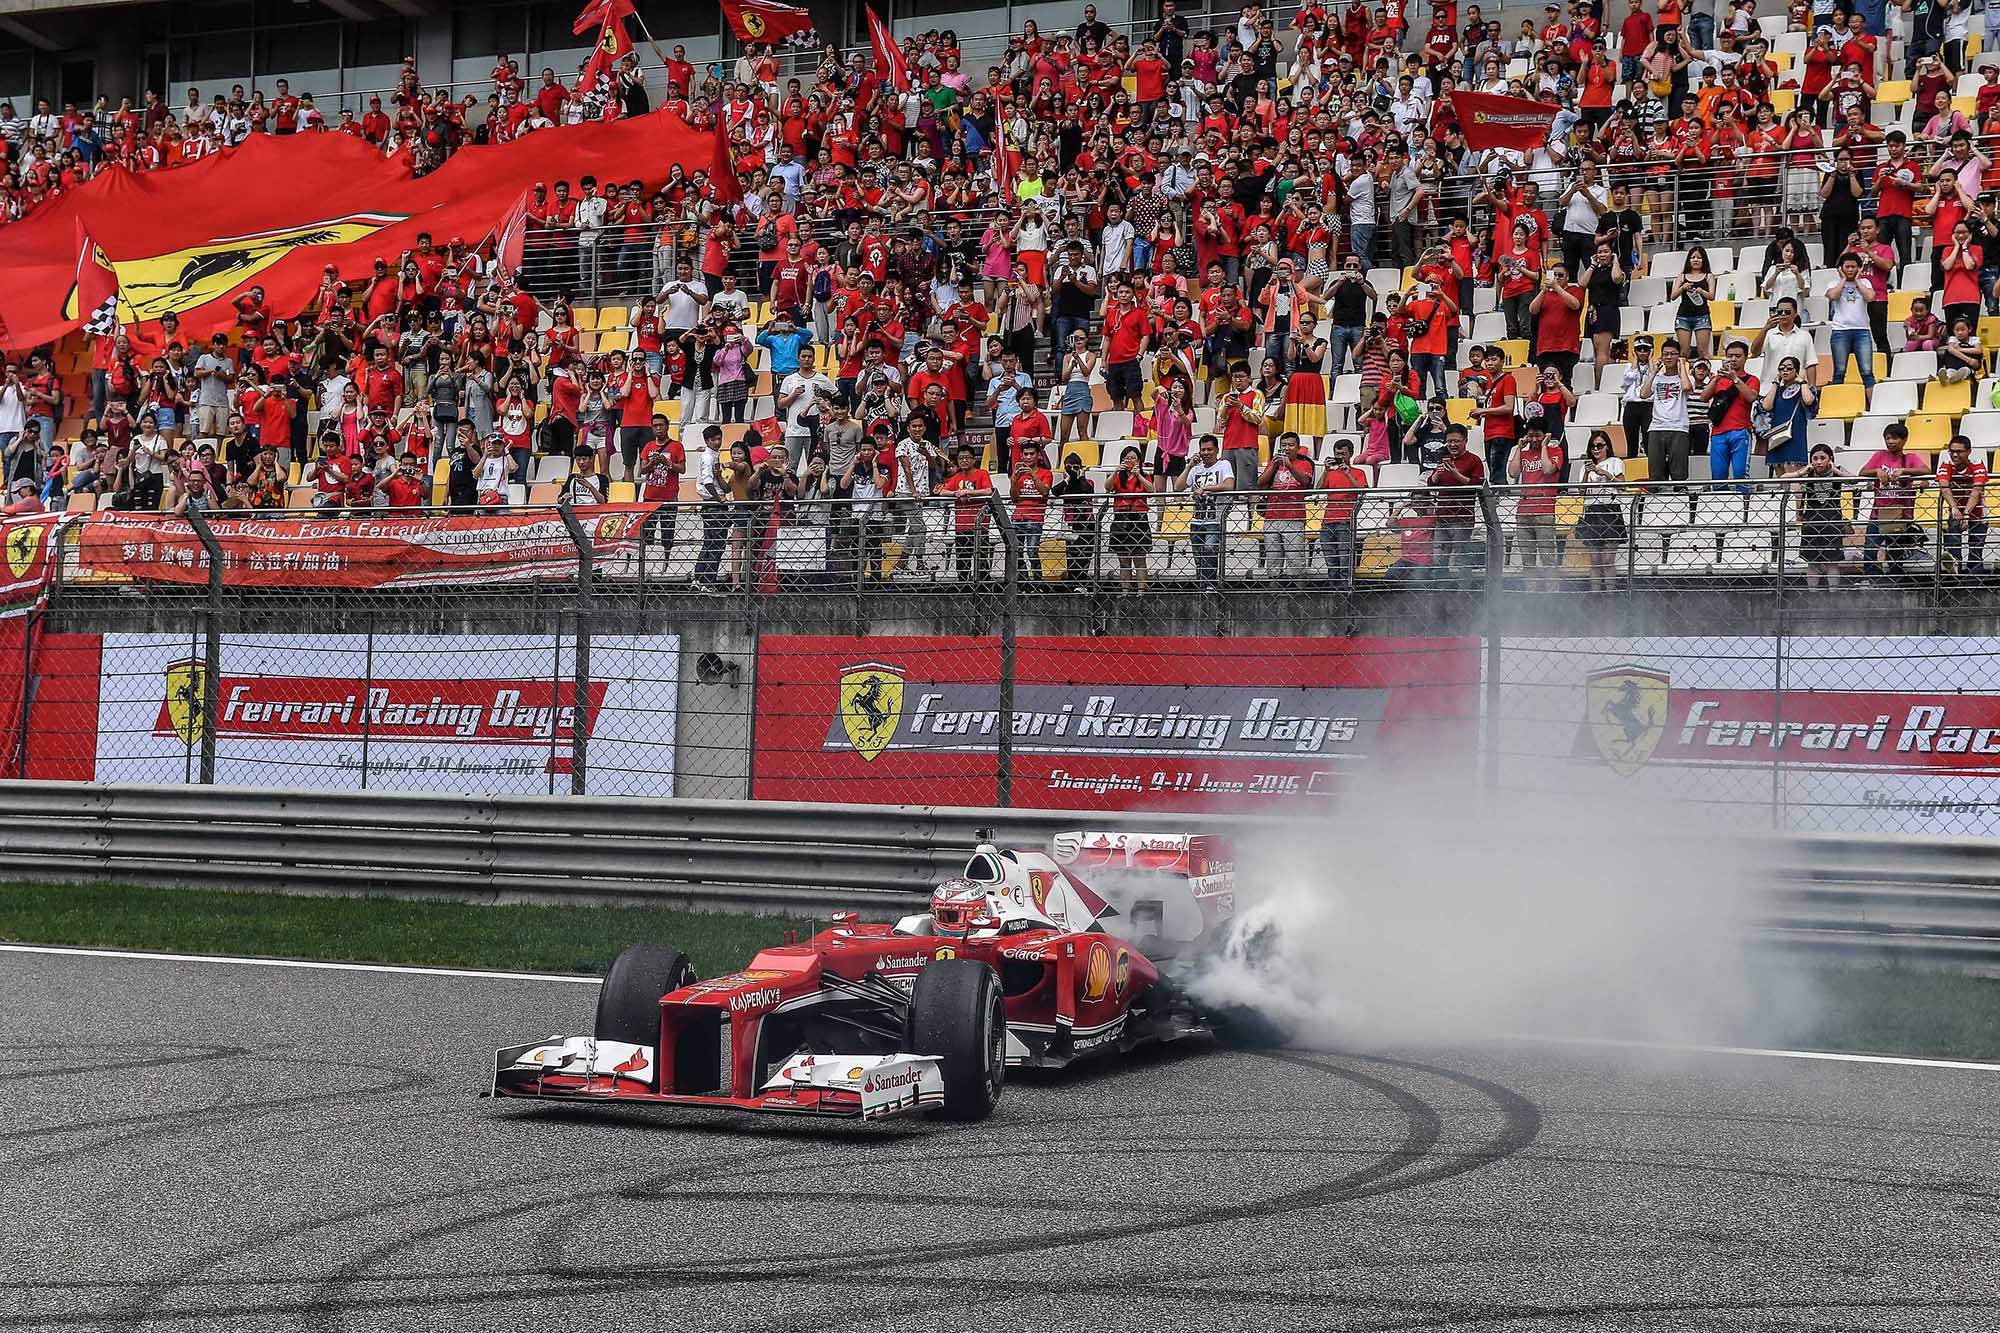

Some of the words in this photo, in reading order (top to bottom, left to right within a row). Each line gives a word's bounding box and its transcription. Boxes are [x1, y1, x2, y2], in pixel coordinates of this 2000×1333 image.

[299, 523, 350, 537] Forza
[508, 544, 554, 560] SHANGHAI
[223, 685, 357, 725] Ferrari
[359, 687, 483, 737] Racing
[488, 688, 577, 738] Days
[909, 692, 1075, 737] Ferrari
[1077, 695, 1232, 750] Racing
[1239, 697, 1359, 752] Days
[1677, 701, 1890, 753] Ferrari
[1048, 769, 1144, 794] Shanghai,
[1149, 771, 1193, 792] 9-11
[1194, 772, 1244, 793] June
[1248, 773, 1301, 795] 2016
[886, 951, 928, 969] Santander
[1003, 947, 1042, 961] Claro
[728, 987, 776, 1013] KASPERSKY
[875, 1066, 922, 1092] Santander
